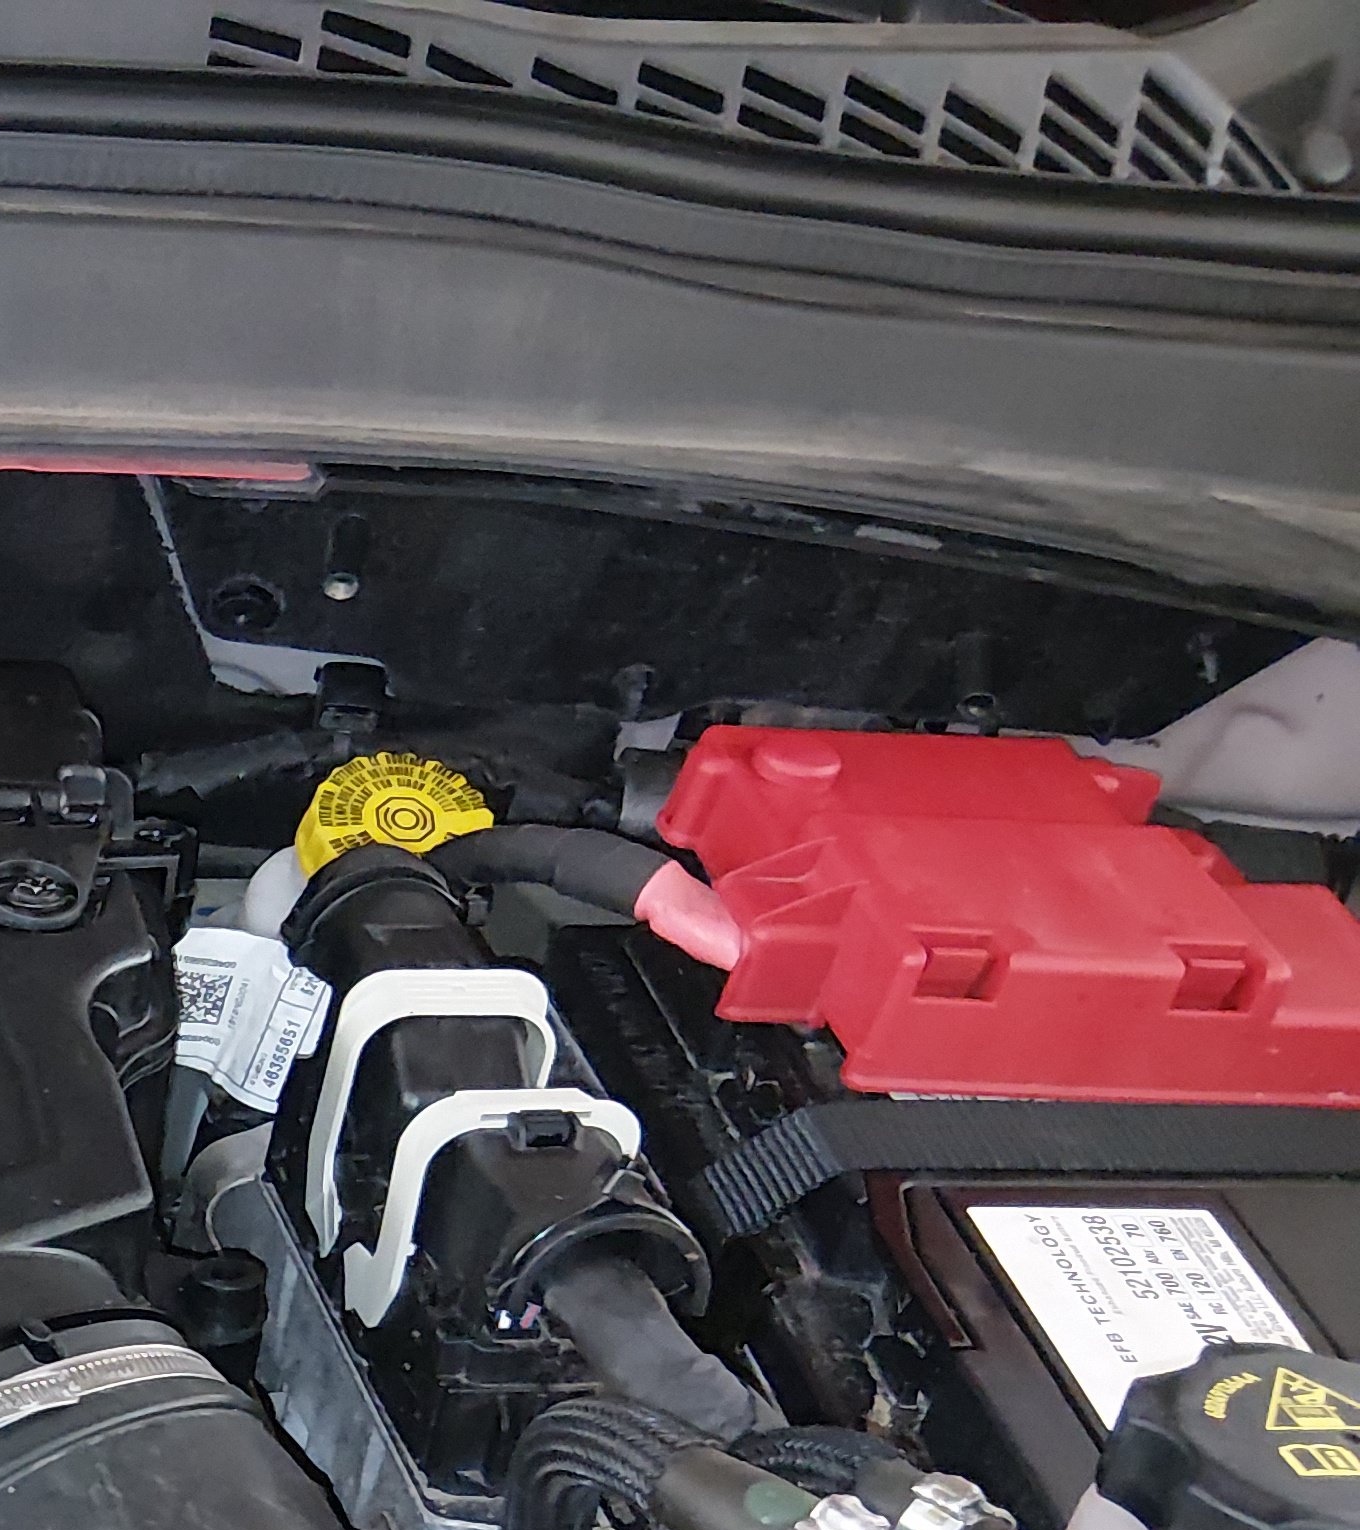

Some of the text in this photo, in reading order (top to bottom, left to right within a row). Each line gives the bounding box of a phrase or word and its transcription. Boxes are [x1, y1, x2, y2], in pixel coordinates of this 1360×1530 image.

[1121, 1223, 1145, 1238] 70
[1148, 1220, 1177, 1242] 760
[1081, 1215, 1159, 1300] 52102538
[1024, 1213, 1138, 1363] EFB TECHNOLOGY
[1156, 1272, 1187, 1295] 700
[1185, 1272, 1215, 1294] 120
